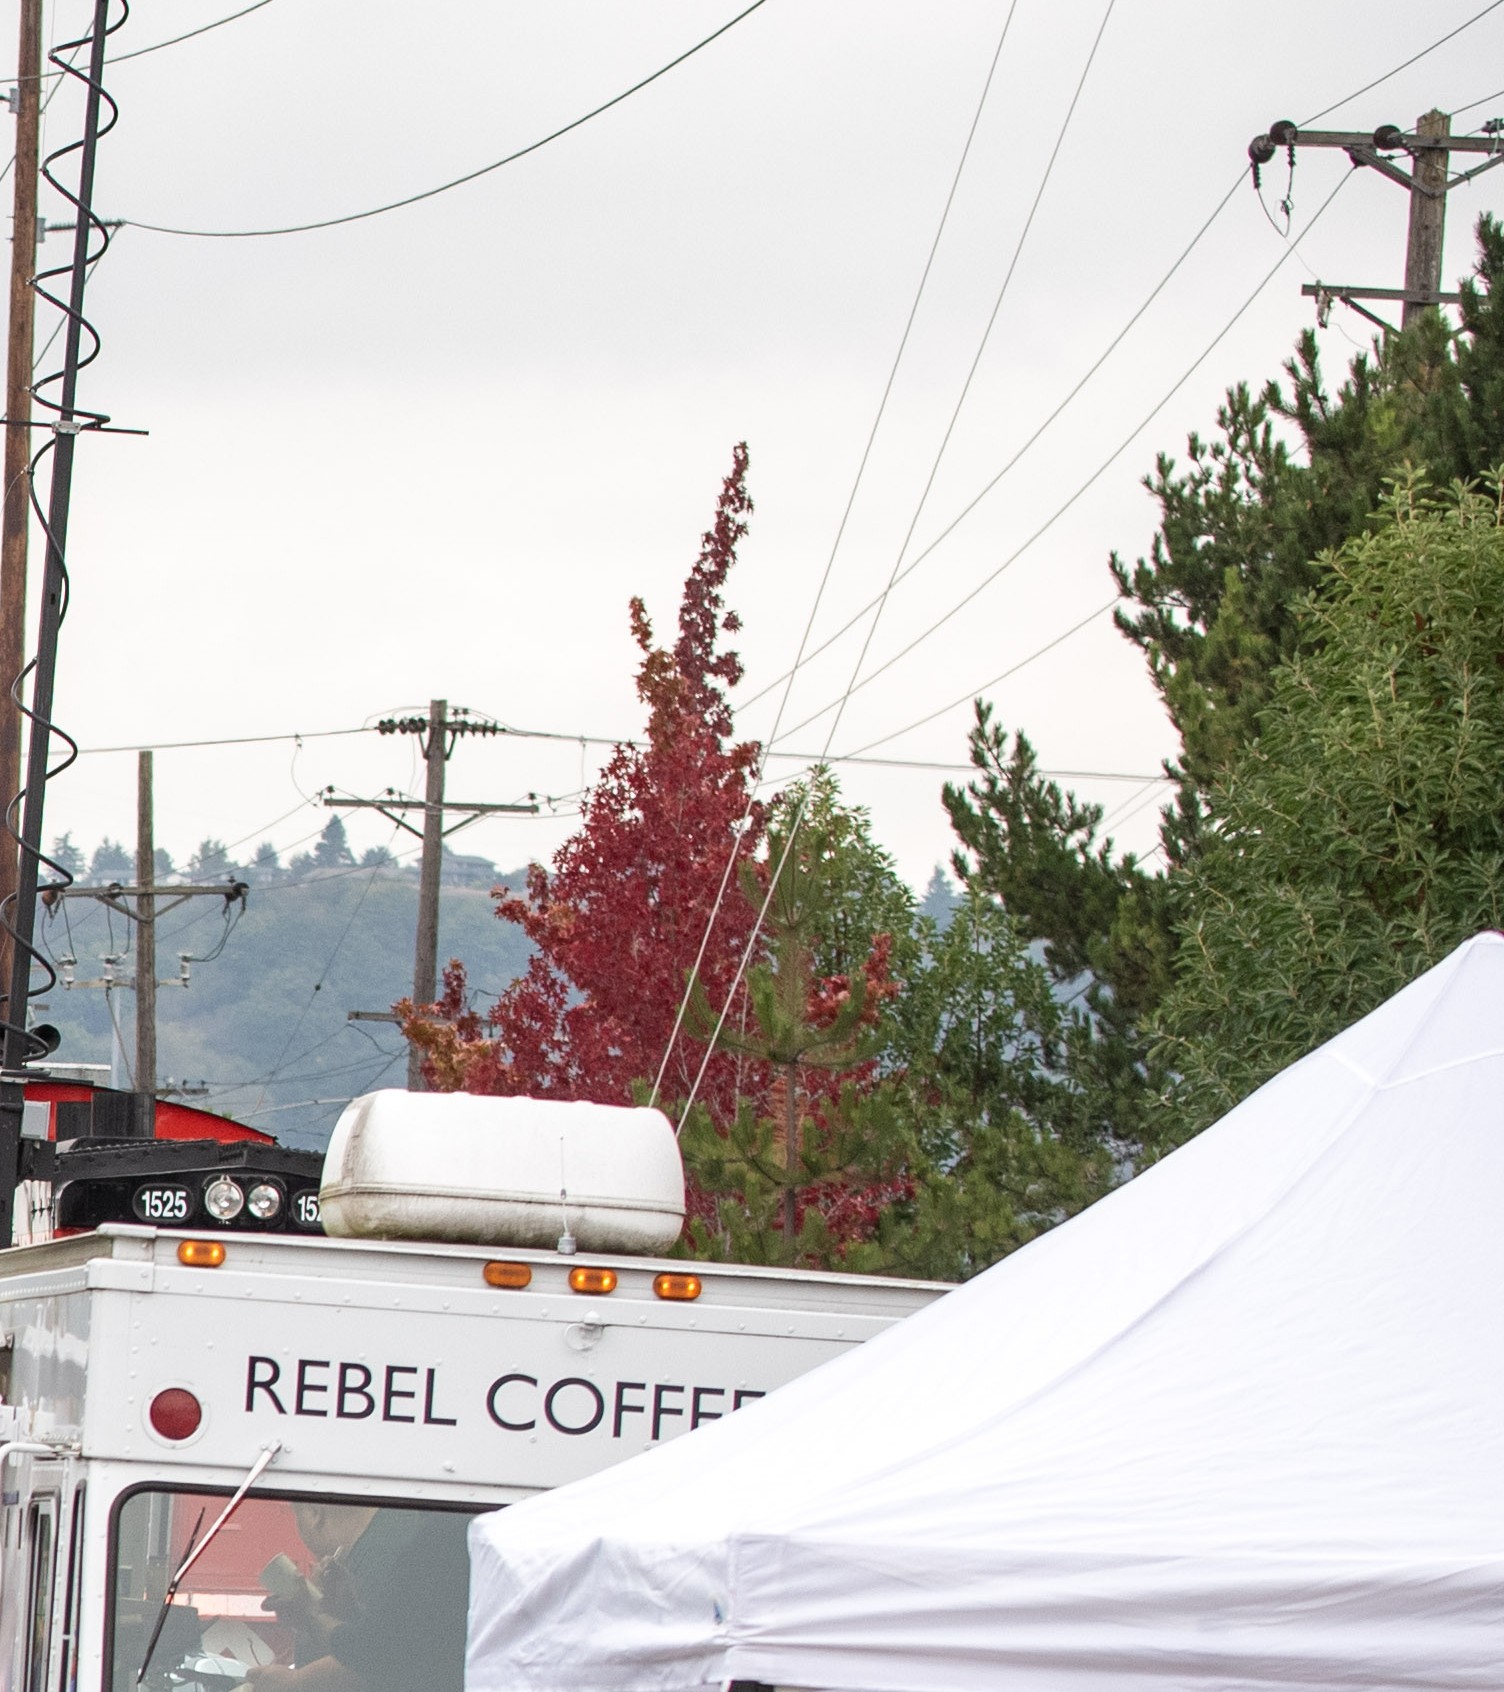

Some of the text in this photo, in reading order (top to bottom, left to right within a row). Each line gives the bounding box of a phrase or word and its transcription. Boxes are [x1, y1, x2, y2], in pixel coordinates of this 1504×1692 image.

[141, 1190, 187, 1218] 1525
[297, 1195, 324, 1222] 15
[243, 1355, 767, 1442] REBEL COFFE
